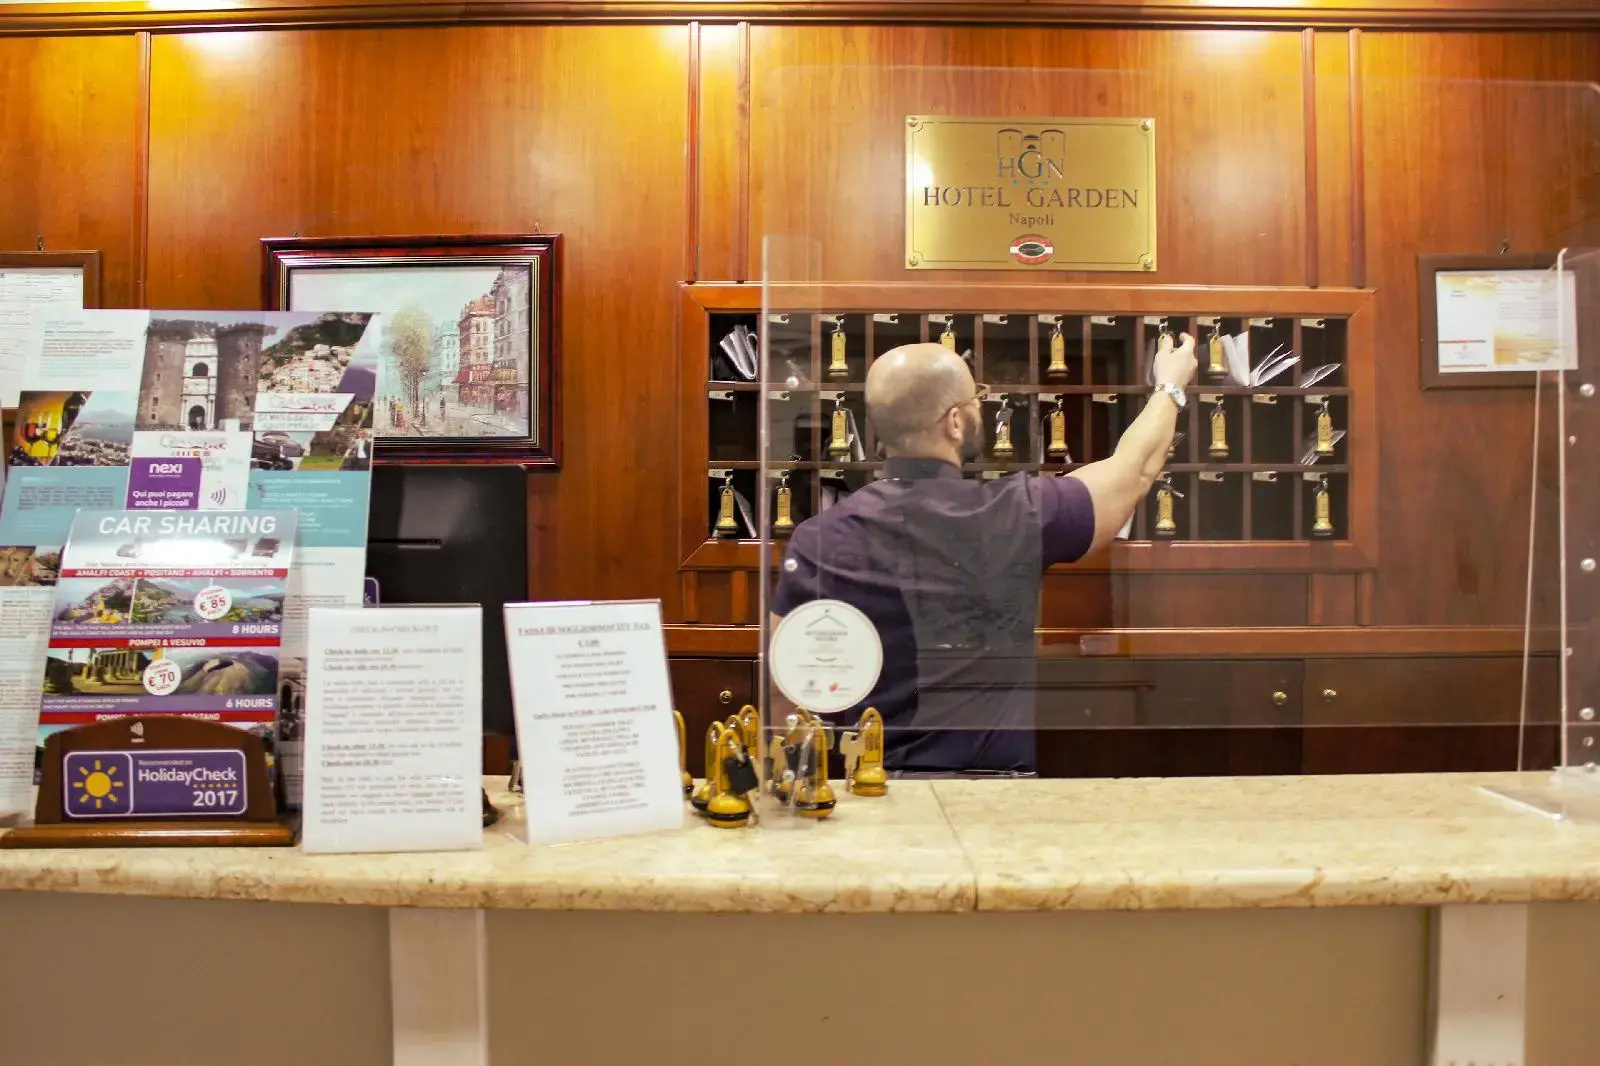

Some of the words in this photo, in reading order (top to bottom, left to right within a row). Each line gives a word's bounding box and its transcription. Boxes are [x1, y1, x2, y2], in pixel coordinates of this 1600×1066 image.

[997, 150, 1065, 179] HGN
[923, 186, 1011, 208] HOTEL
[1026, 188, 1139, 209] GARDEN
[1008, 213, 1055, 229] Napoli
[149, 463, 183, 474] nexi
[132, 490, 147, 498] Qui
[148, 490, 166, 498] puoi
[134, 499, 158, 507] anche
[163, 499, 189, 508] piccoli
[99, 516, 151, 534] CAR
[157, 516, 277, 535] SHARING
[76, 569, 107, 577] AMALFI
[108, 569, 136, 577] COAST
[192, 569, 223, 577] AMALFI
[210, 597, 226, 608] 85
[231, 625, 240, 634] 8
[241, 625, 279, 634] HOURS
[128, 638, 160, 647] POMPEI
[162, 639, 169, 647] &
[170, 638, 206, 646] VESUVIO
[159, 671, 175, 683] 70
[226, 699, 233, 708] 6
[235, 698, 274, 708] HOURS
[138, 766, 238, 786] HolidayCheck
[192, 790, 238, 806] 2017
